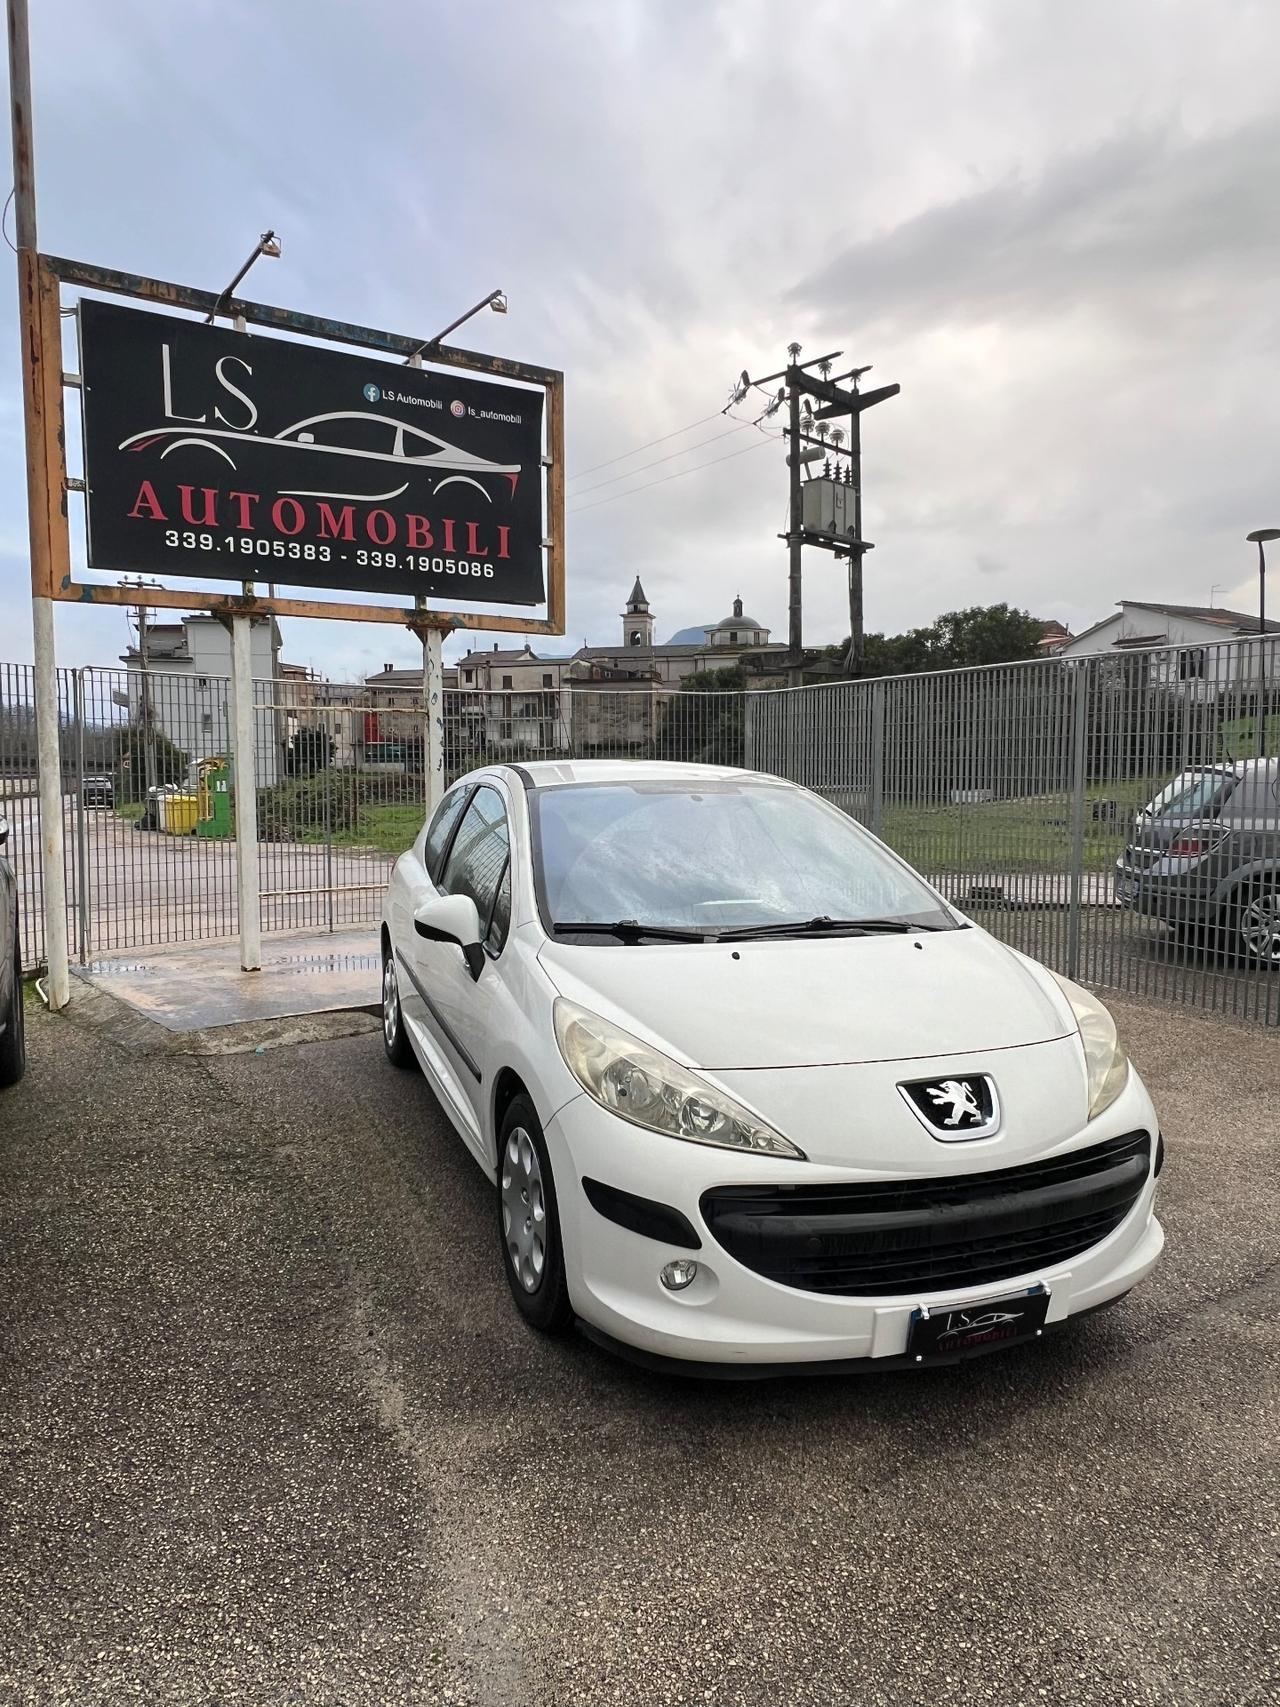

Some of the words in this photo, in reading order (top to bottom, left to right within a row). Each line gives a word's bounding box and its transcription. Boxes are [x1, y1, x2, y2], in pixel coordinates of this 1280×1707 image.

[162, 343, 258, 430] LS
[382, 390, 395, 401] LS
[396, 393, 443, 410] Automobili
[127, 480, 511, 559] AUTOMOBILI
[165, 530, 331, 562] 339.1905383
[356, 550, 495, 578] 339.1905086
